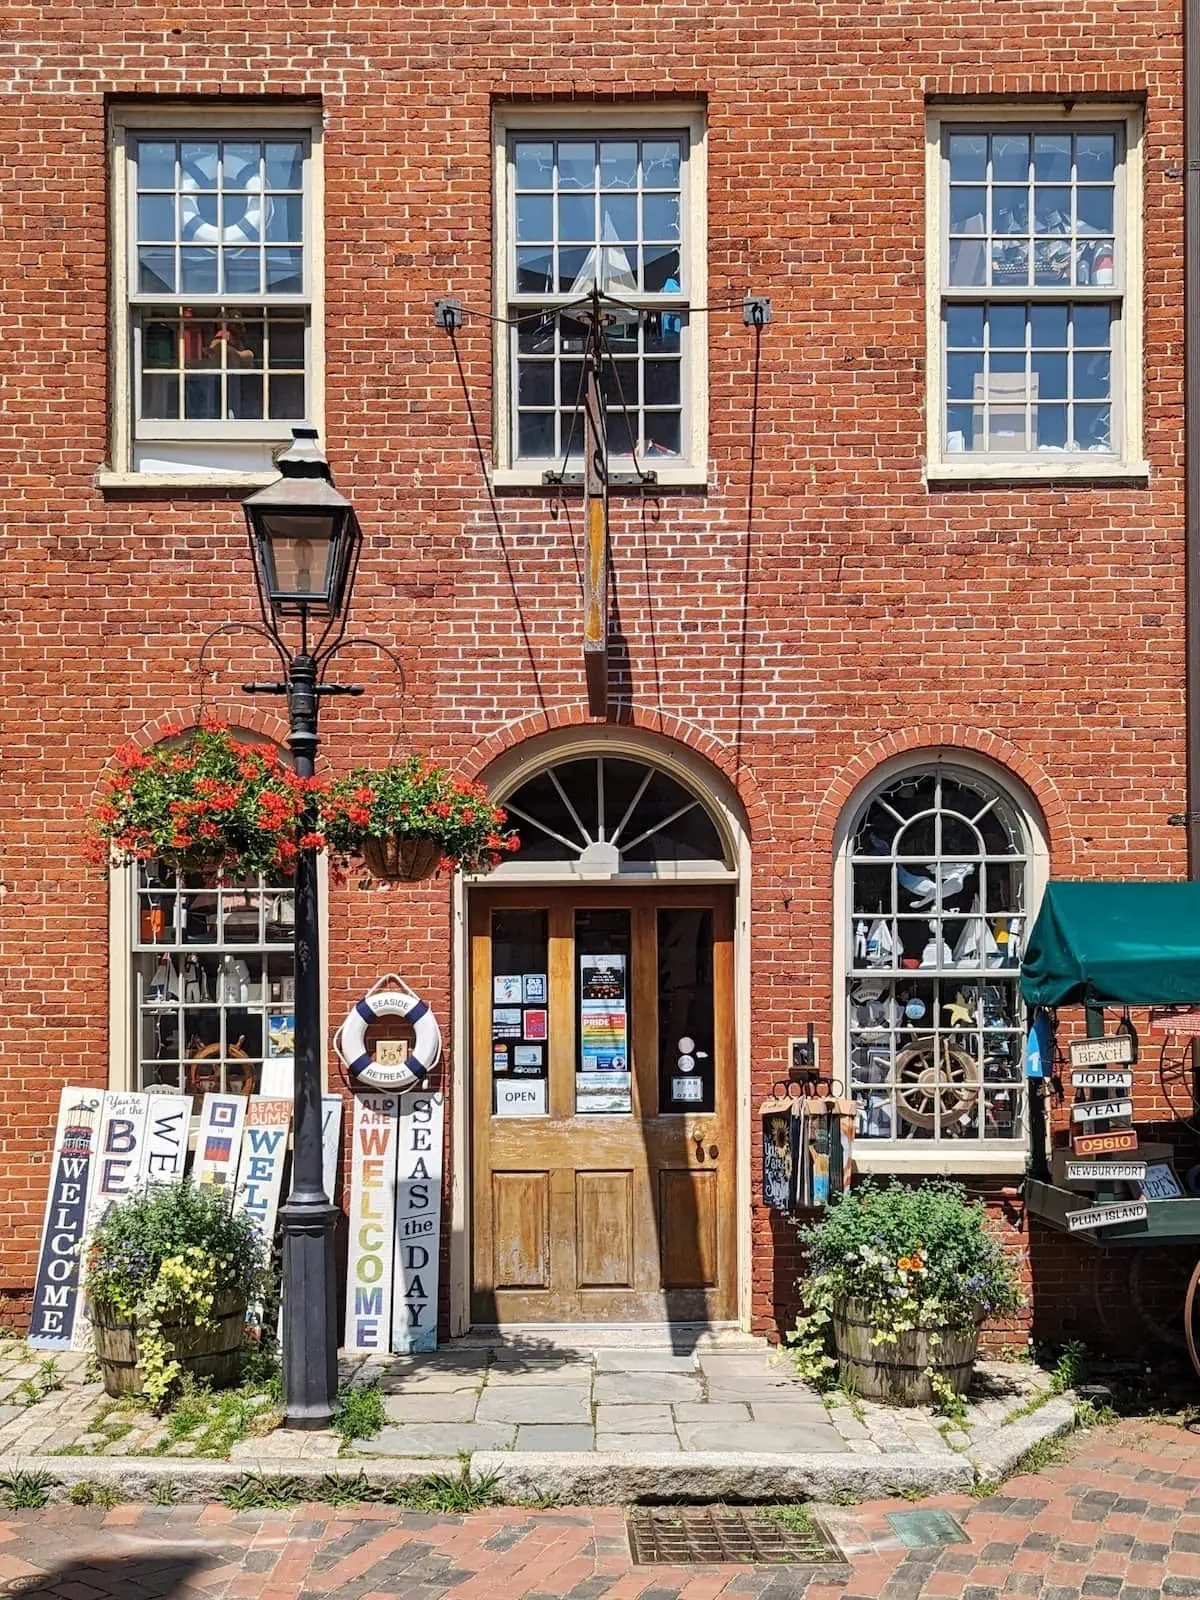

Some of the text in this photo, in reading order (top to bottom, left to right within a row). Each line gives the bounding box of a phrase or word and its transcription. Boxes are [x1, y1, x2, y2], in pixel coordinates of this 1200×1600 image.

[371, 998, 410, 1010] SEASIDE
[583, 1018, 610, 1026] PRIDE
[1079, 1049, 1122, 1064] BEACH
[366, 1068, 407, 1081] RETREAT
[1079, 1073, 1125, 1085] JOPPA
[106, 1095, 141, 1108] You're
[505, 1091, 536, 1102] OPEN
[115, 1105, 144, 1115] at the
[249, 1101, 290, 1114] BEACH
[1082, 1102, 1122, 1117] YEAT
[249, 1112, 289, 1125] BUMS
[359, 1113, 391, 1125] ARE
[407, 1099, 433, 1209] SEAS
[1069, 1165, 1143, 1177] NEWBURYPORT
[1071, 1205, 1144, 1228] PLUM ISLAND
[404, 1219, 433, 1235] the
[354, 1128, 391, 1347] WELCOME
[39, 1157, 88, 1333] WELCOME
[403, 1244, 429, 1328] DAY
